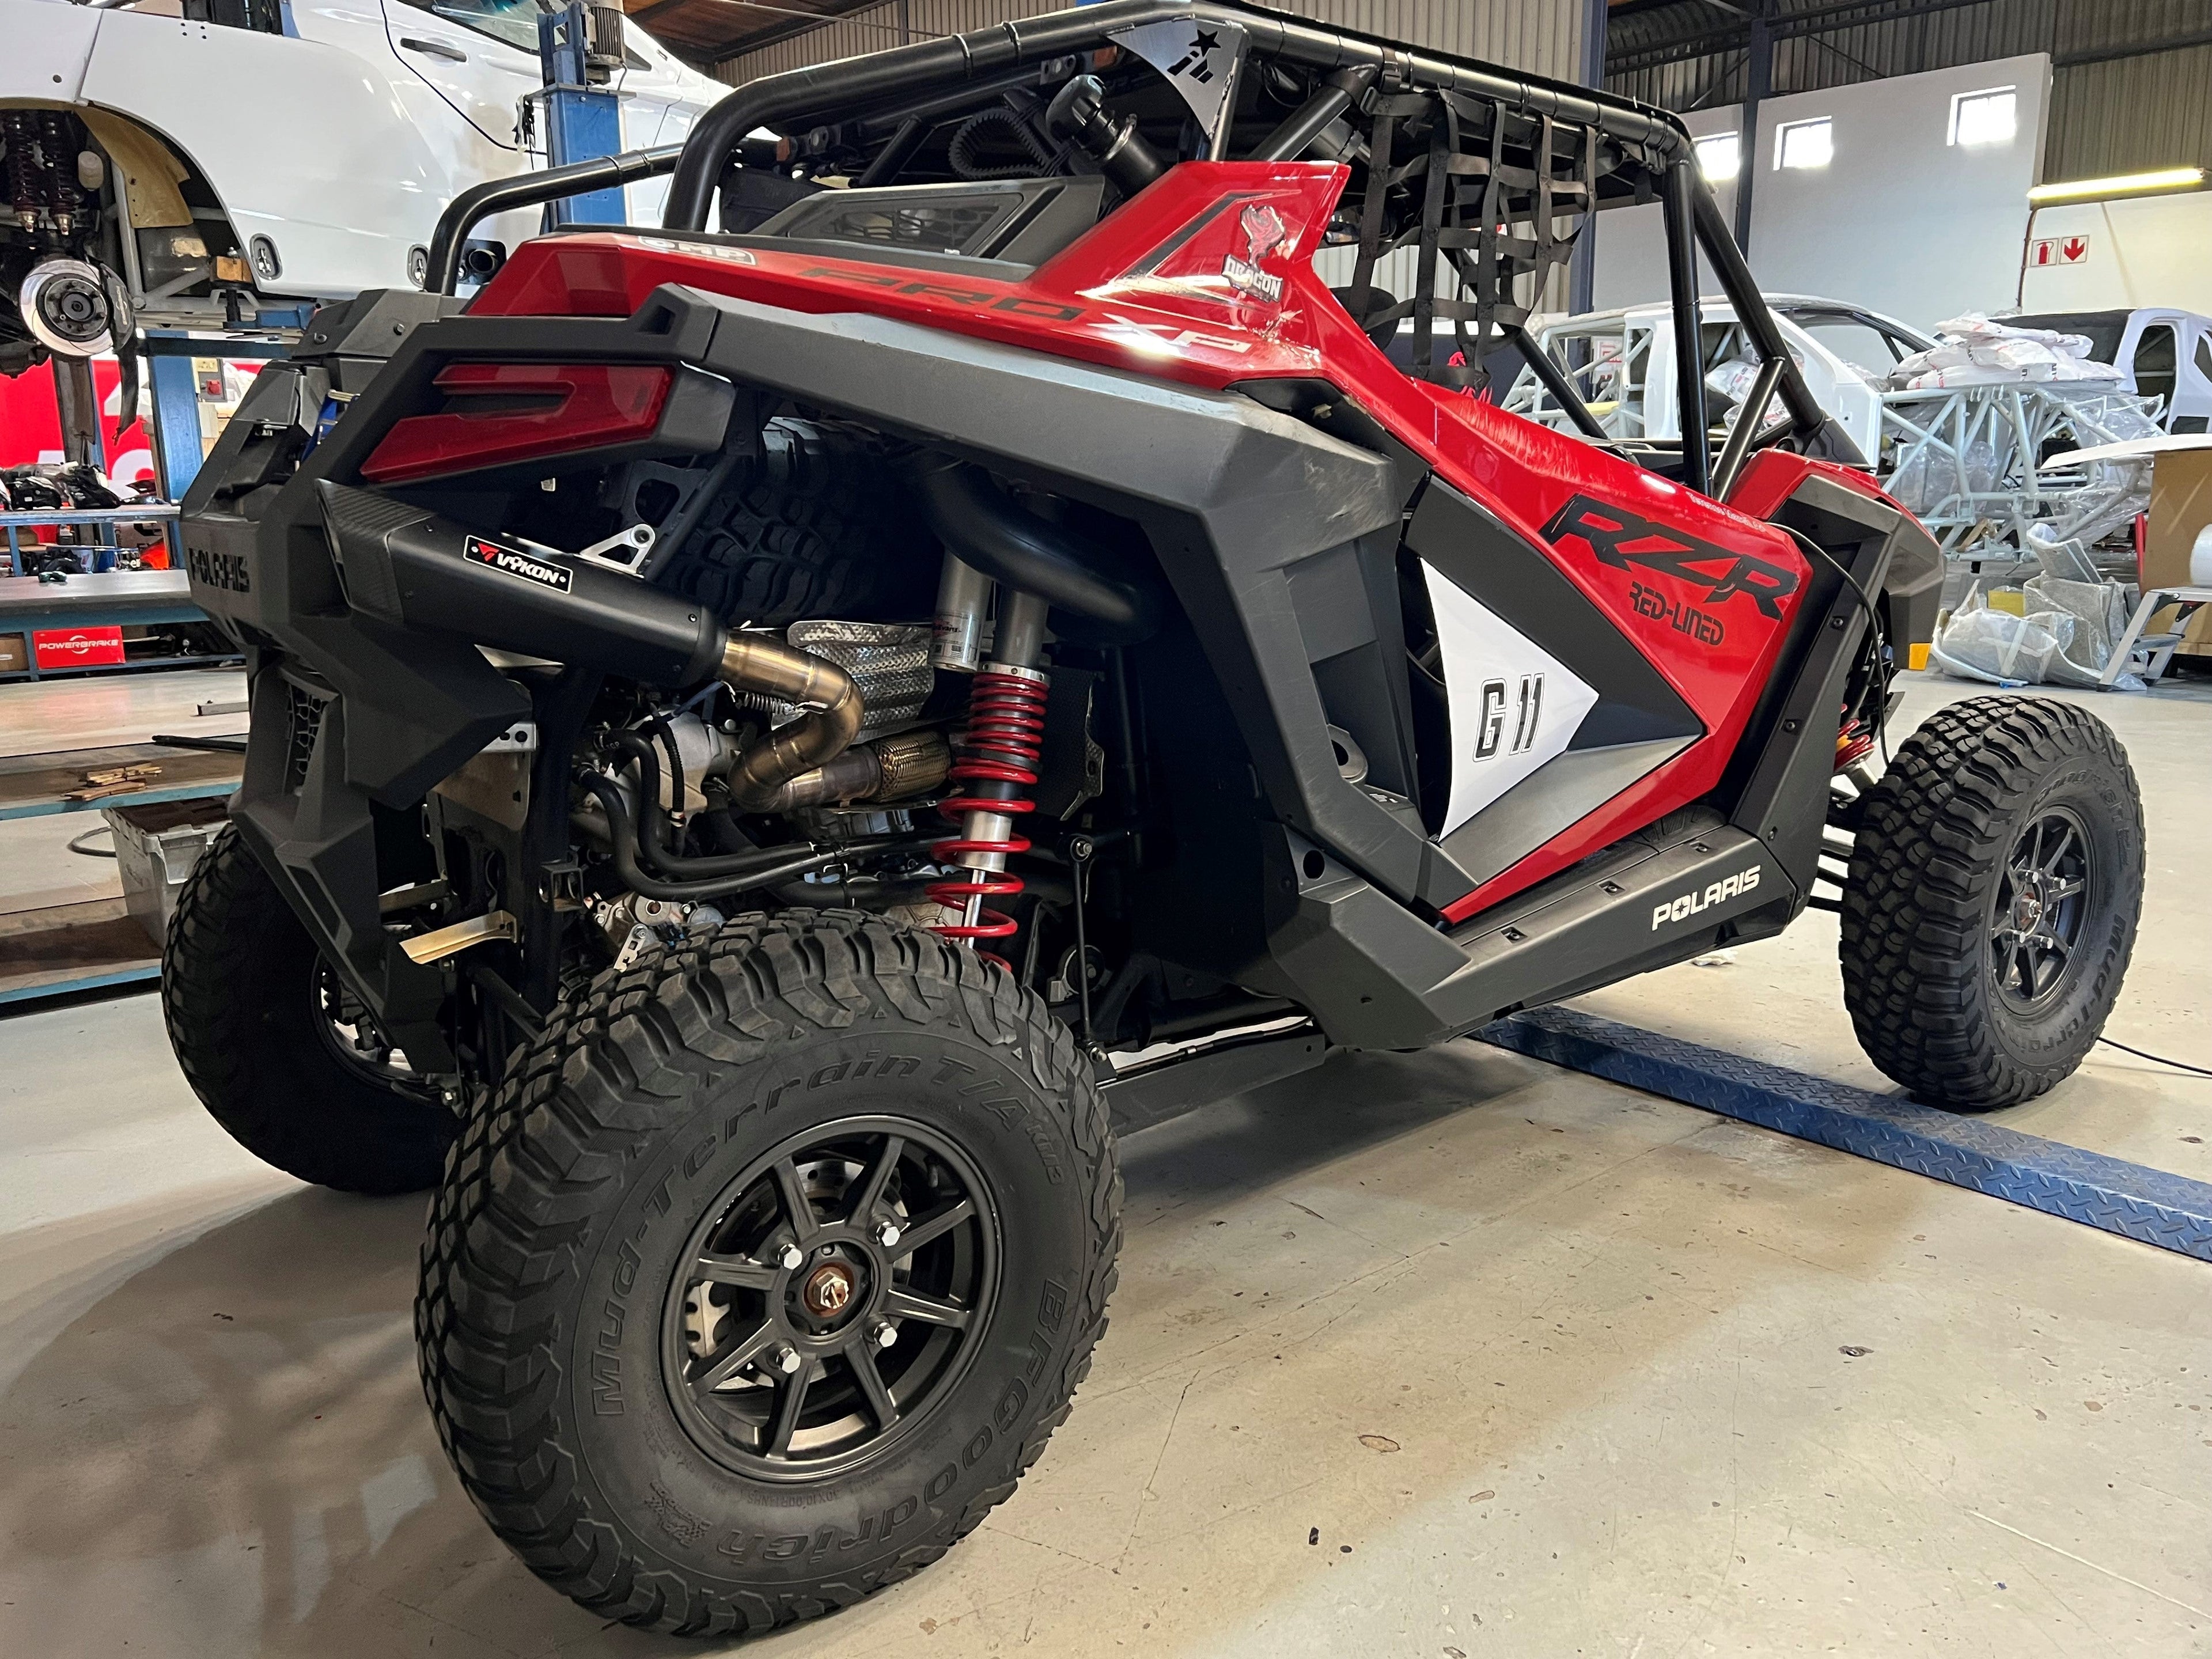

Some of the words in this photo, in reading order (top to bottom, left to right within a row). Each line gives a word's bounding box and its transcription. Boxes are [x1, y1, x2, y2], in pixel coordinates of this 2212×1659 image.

[797, 267, 1086, 321] PRO
[1224, 256, 1282, 300] DRAGON
[188, 547, 250, 593] POLARIS
[1537, 493, 1799, 621] RZR
[39, 639, 119, 650] POWERBRAKE
[1628, 581, 1725, 646] RED-LINED
[1652, 865, 1761, 931] POLARIS
[591, 1048, 922, 1416] Mud-Terrain
[717, 1279, 1068, 1564] BFGoodrich
